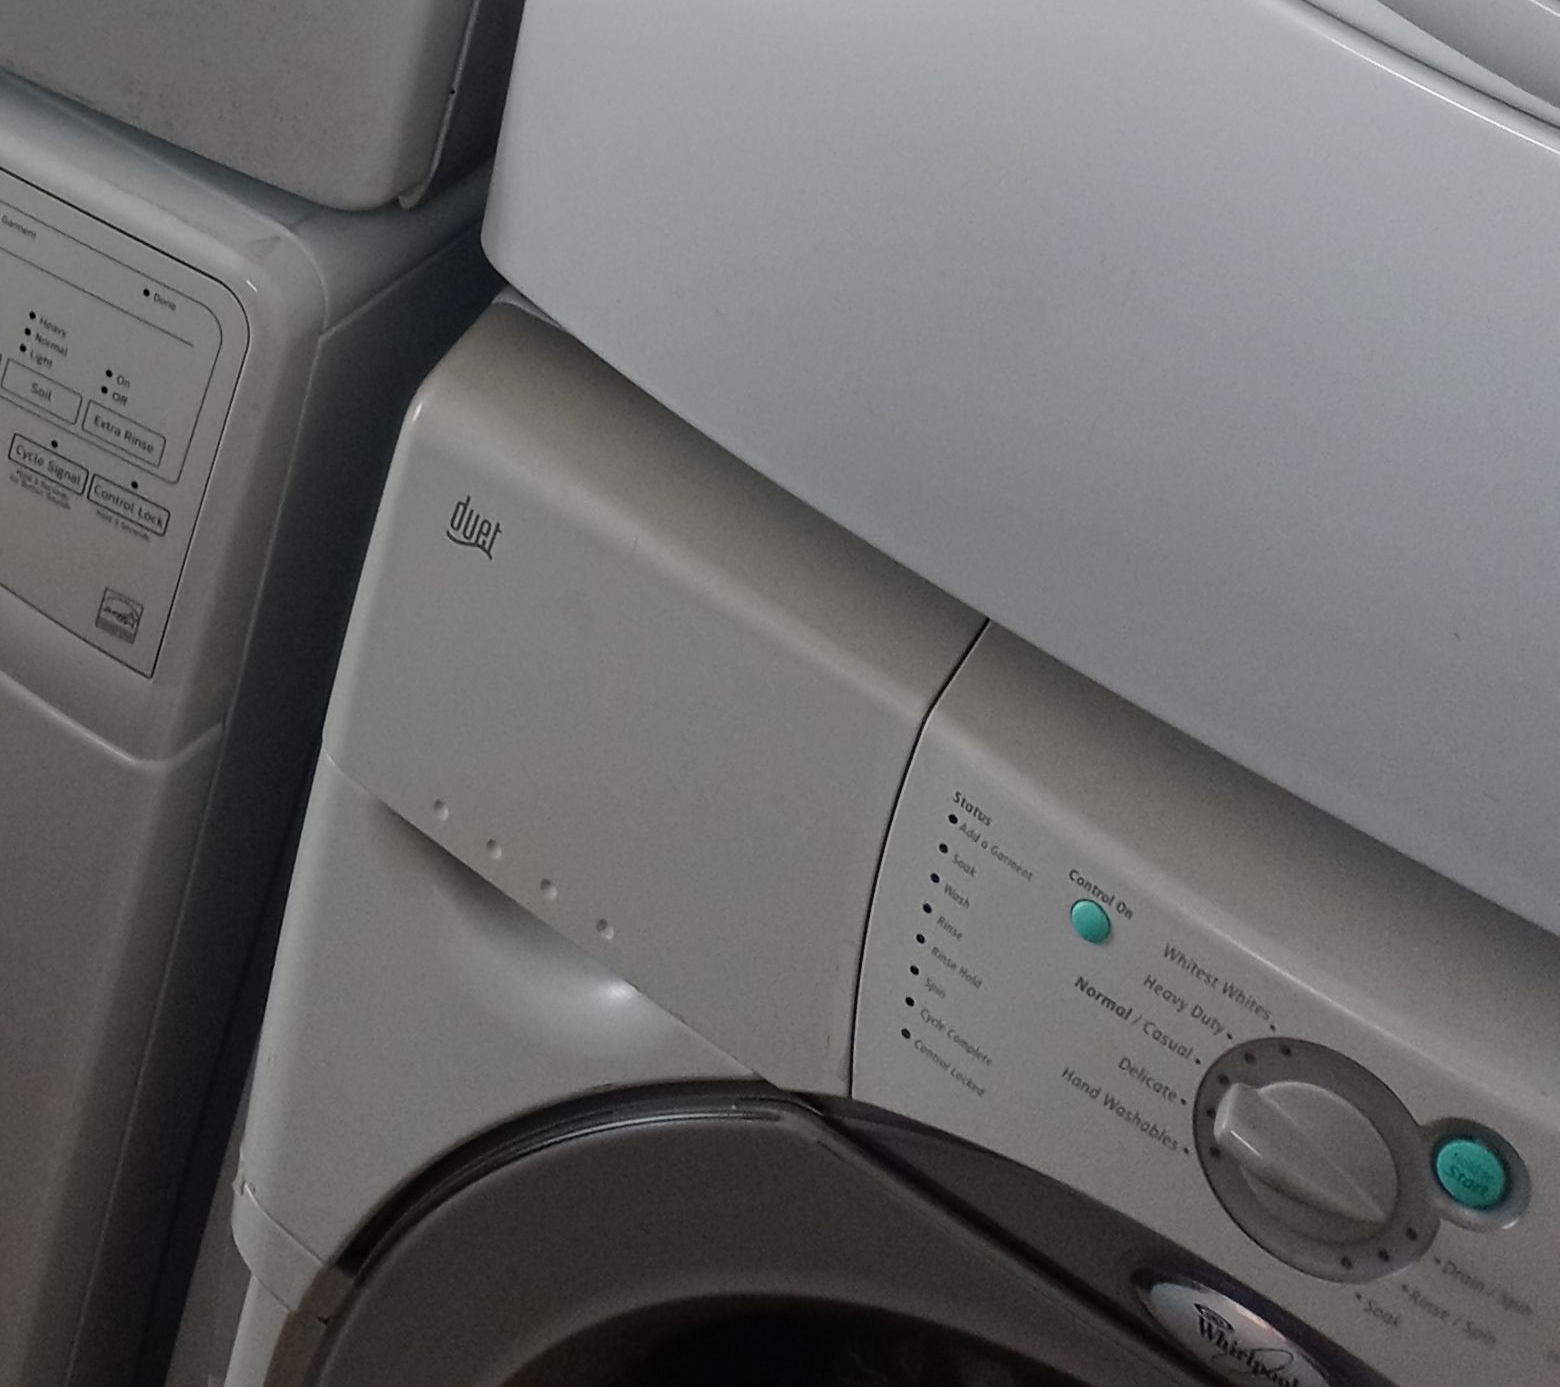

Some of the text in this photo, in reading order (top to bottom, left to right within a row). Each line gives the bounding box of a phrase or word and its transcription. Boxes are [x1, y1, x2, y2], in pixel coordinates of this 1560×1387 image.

[1, 213, 37, 239] Garment
[153, 293, 177, 311] Done
[35, 333, 68, 357] Normal
[40, 318, 66, 339] Heavy
[30, 351, 53, 369] Light
[31, 382, 51, 402] Soil
[112, 392, 128, 406] Off
[117, 376, 130, 389] On
[94, 415, 154, 454] Extra Rinse
[16, 445, 43, 467] Cycle
[47, 461, 81, 486] Signal
[94, 485, 134, 513] Control
[137, 506, 163, 528] Lock
[447, 495, 502, 559] duet
[953, 791, 992, 827] Status
[953, 853, 976, 878] Soak
[959, 822, 1033, 881] Add Garment
[944, 883, 970, 909] Wash
[1069, 869, 1134, 920] Control On
[937, 916, 963, 940] Rinse
[931, 946, 983, 988] Rinse Hold
[1164, 944, 1273, 1021] Whitest Whites
[925, 978, 946, 998] Spin
[1143, 975, 1226, 1035] Heavy Duty
[1074, 976, 1193, 1059] Normal Casual
[920, 1008, 991, 1066] Cycle Complete
[914, 1039, 985, 1096] Control Locked
[1118, 1057, 1177, 1102] Delicate
[1061, 1067, 1180, 1151] Hand Washables
[1447, 1164, 1489, 1197] Start
[1364, 1300, 1399, 1327] Soak
